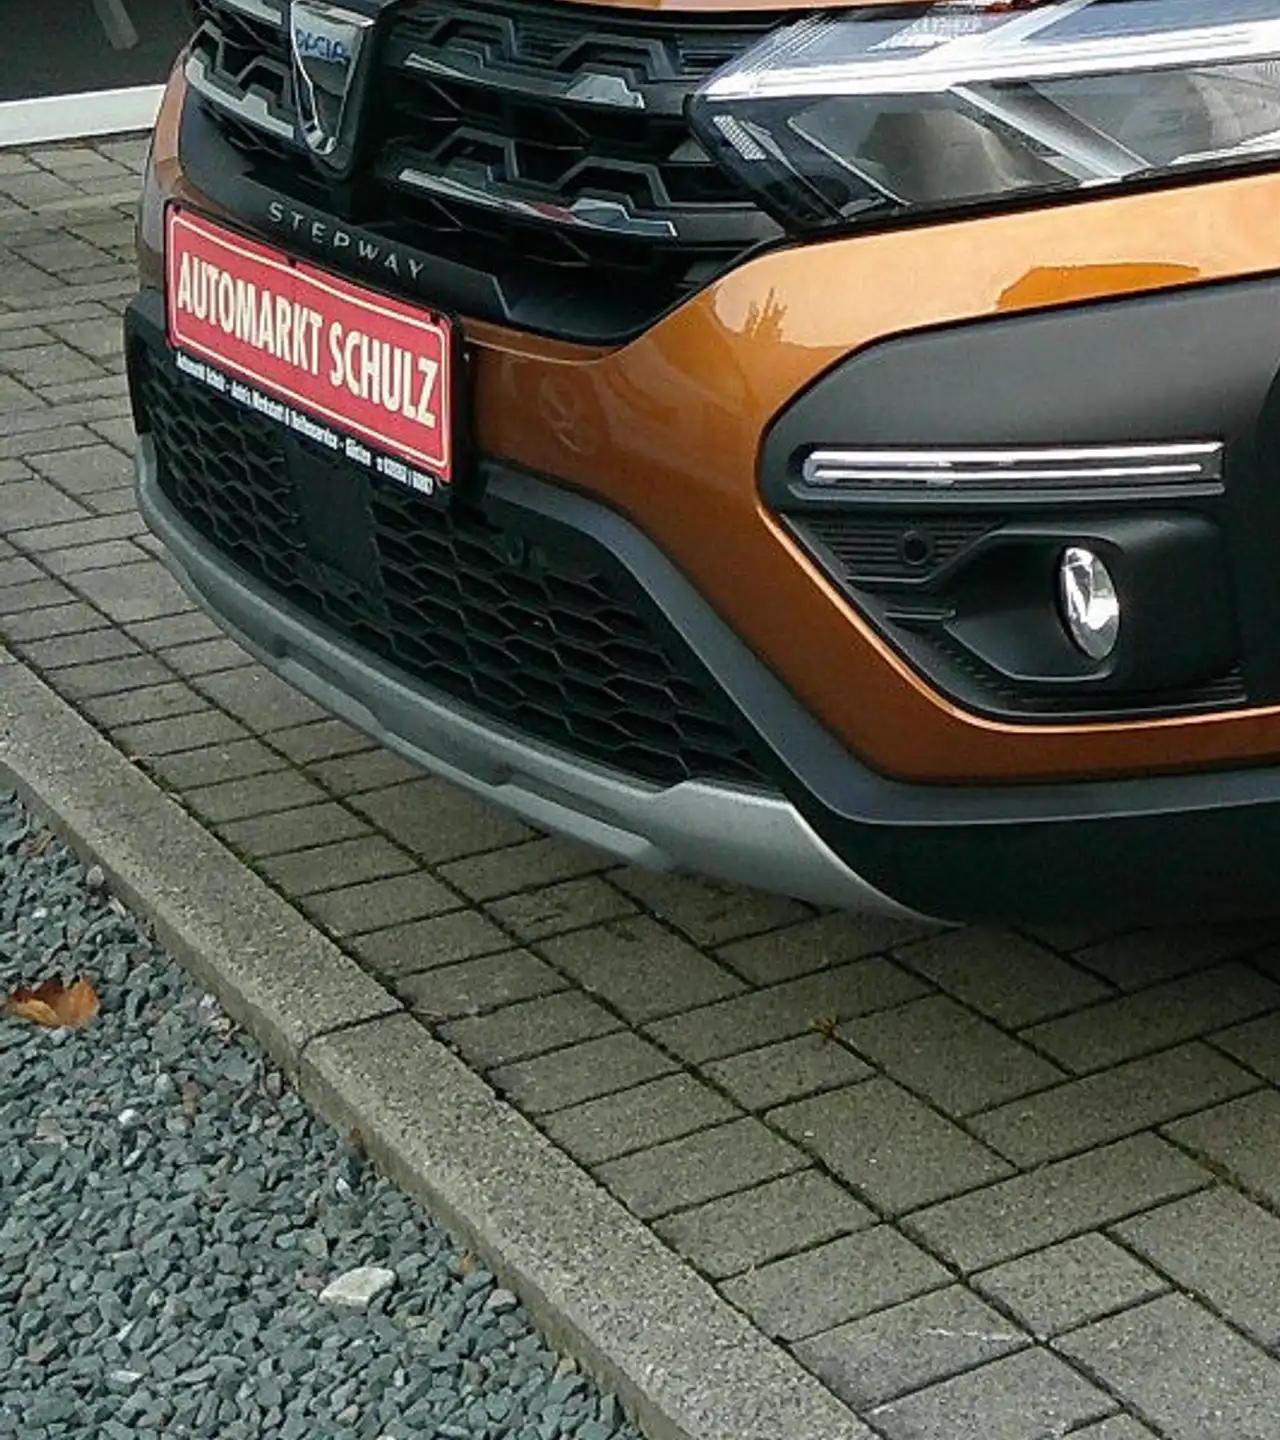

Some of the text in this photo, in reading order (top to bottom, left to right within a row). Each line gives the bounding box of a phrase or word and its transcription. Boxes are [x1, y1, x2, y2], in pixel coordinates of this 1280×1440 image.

[268, 201, 424, 280] STEPWAY
[177, 250, 324, 375] AUTOMARKT
[328, 320, 438, 429] SCHULZ
